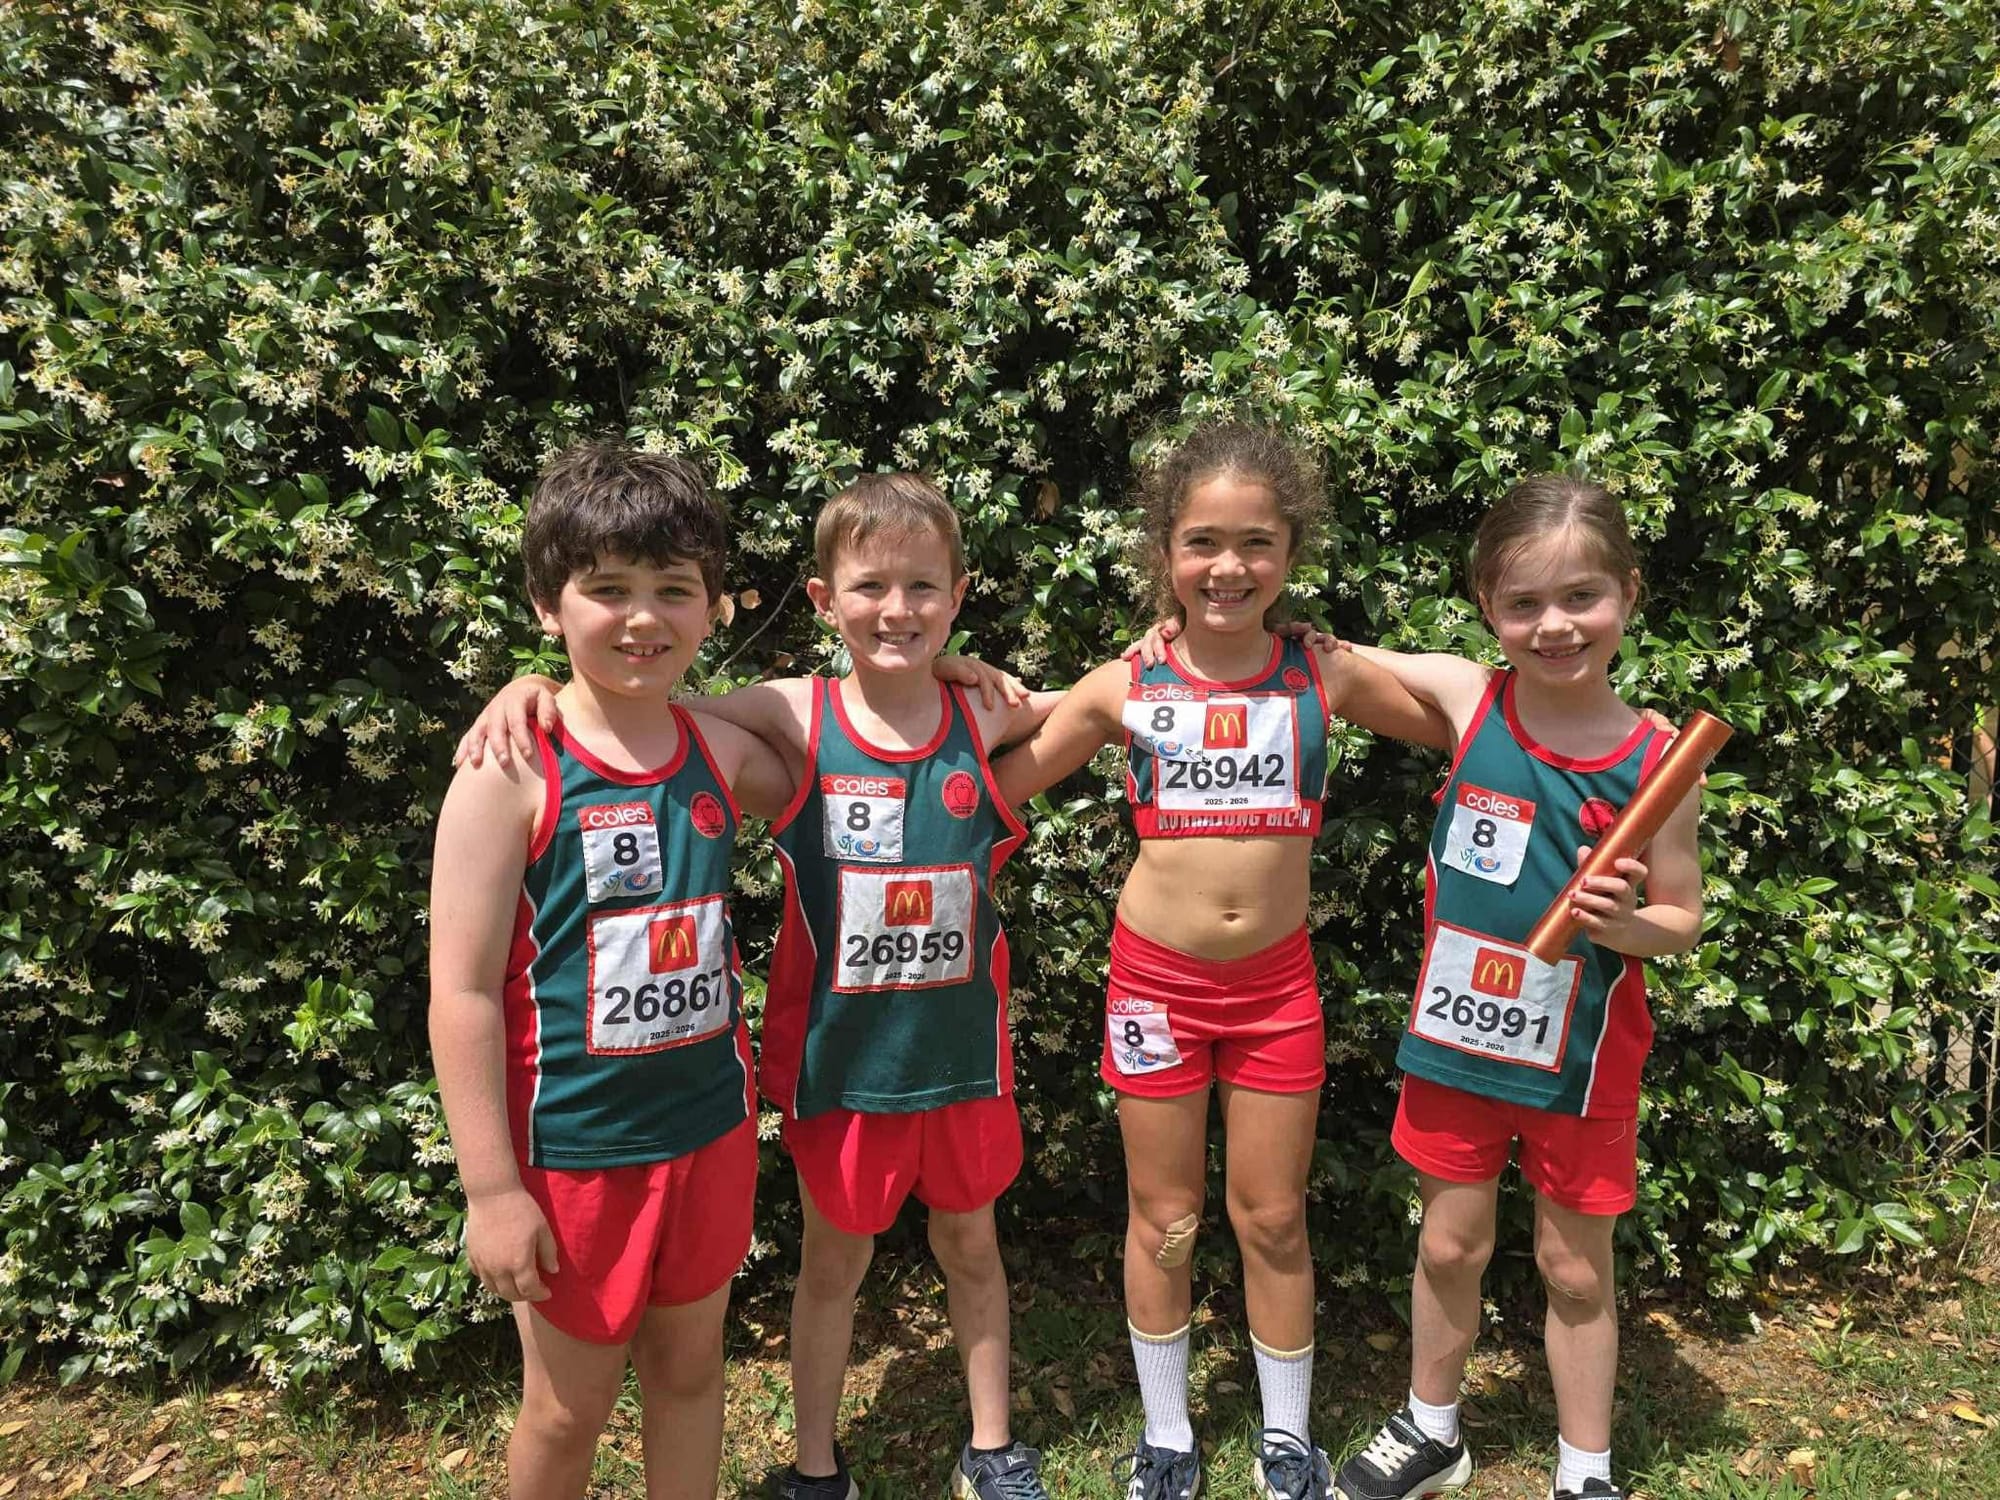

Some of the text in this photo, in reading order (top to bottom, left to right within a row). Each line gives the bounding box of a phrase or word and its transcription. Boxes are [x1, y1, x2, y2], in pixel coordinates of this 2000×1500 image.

[1142, 687, 1195, 701] coles
[1150, 705, 1175, 733] 8
[1165, 753, 1286, 789] 26942
[833, 777, 889, 796] coles
[1230, 797, 1248, 805] 2026
[1465, 793, 1520, 819] coles
[588, 806, 648, 827] coles
[846, 802, 871, 831] 8
[1472, 818, 1498, 848] 8
[613, 832, 640, 866] 8
[845, 930, 964, 968] 26959
[602, 968, 722, 1025] 26867
[1111, 996, 1154, 1014] coles
[1425, 985, 1550, 1045] 26991
[650, 1030, 670, 1040] 2025
[675, 1023, 695, 1034] 2026
[1124, 1020, 1144, 1047] 8
[1460, 1035, 1479, 1047] 2025
[1485, 1041, 1505, 1052] 2026
